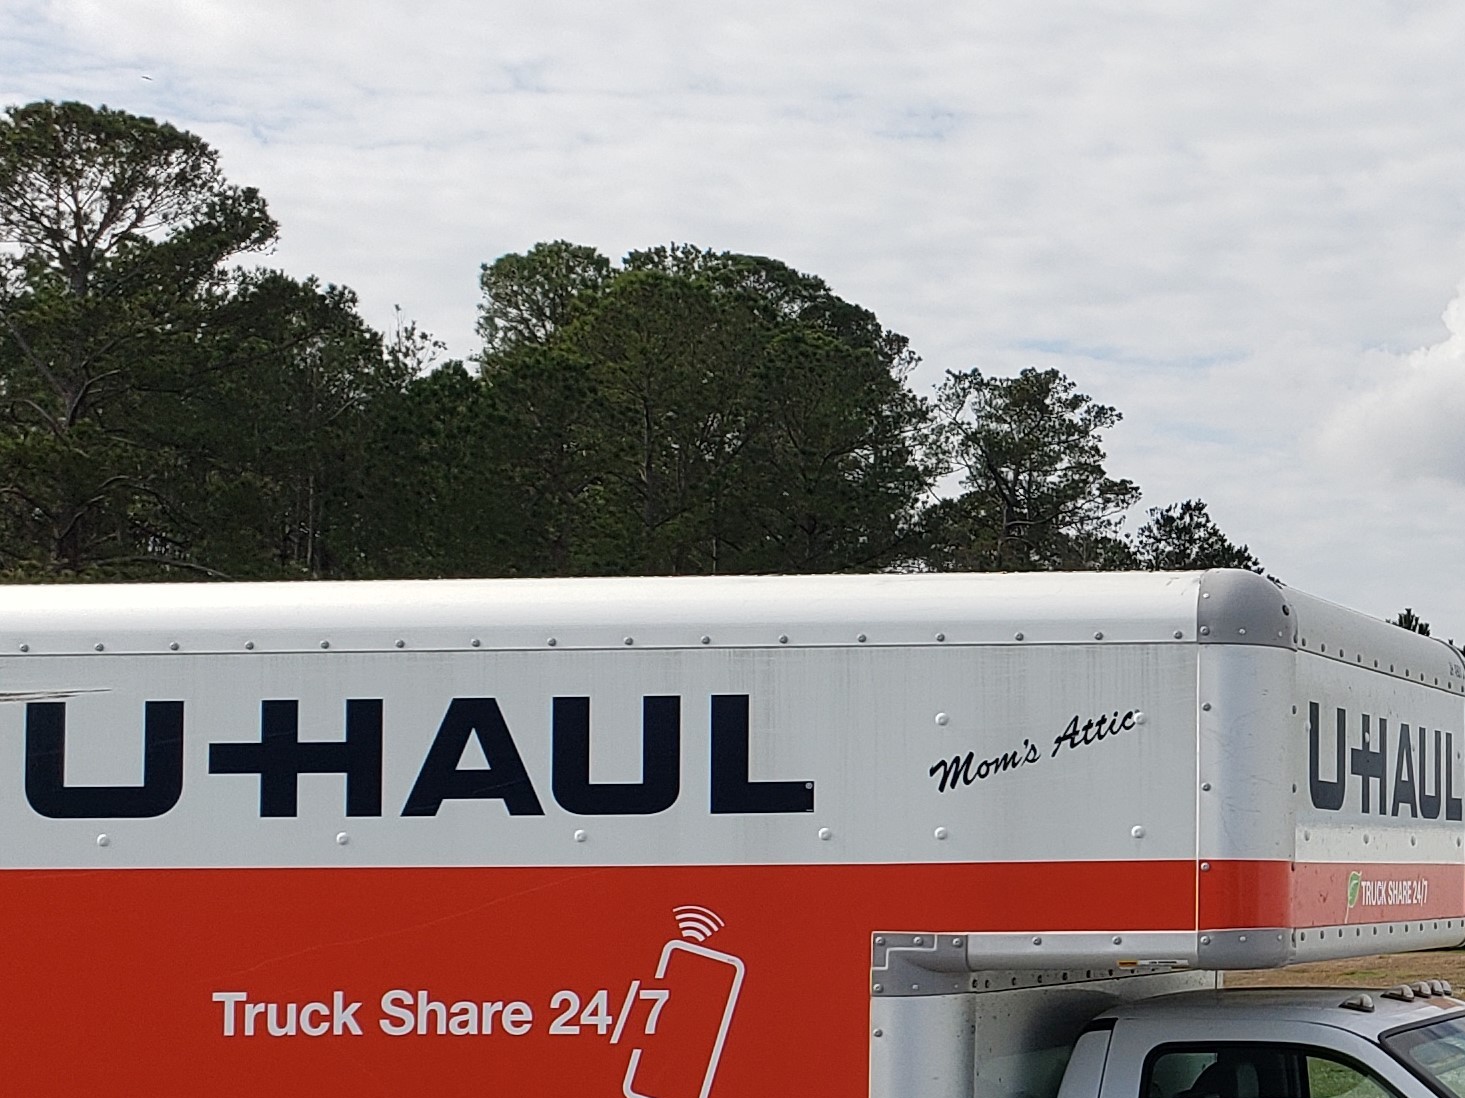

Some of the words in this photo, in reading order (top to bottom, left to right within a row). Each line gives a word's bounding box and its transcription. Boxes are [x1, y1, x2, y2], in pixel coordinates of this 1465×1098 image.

[25, 694, 815, 819] U-HAUL
[929, 738, 1041, 793] Mom's
[1051, 709, 1138, 758] Attic
[1309, 701, 1463, 822] U-HAUL
[1361, 880, 1387, 906] TRUCK
[1388, 880, 1412, 906] SHARE
[1412, 878, 1428, 907] 24/7
[212, 990, 364, 1037] Truck
[379, 989, 533, 1037] Share
[548, 980, 670, 1044] 24/7
